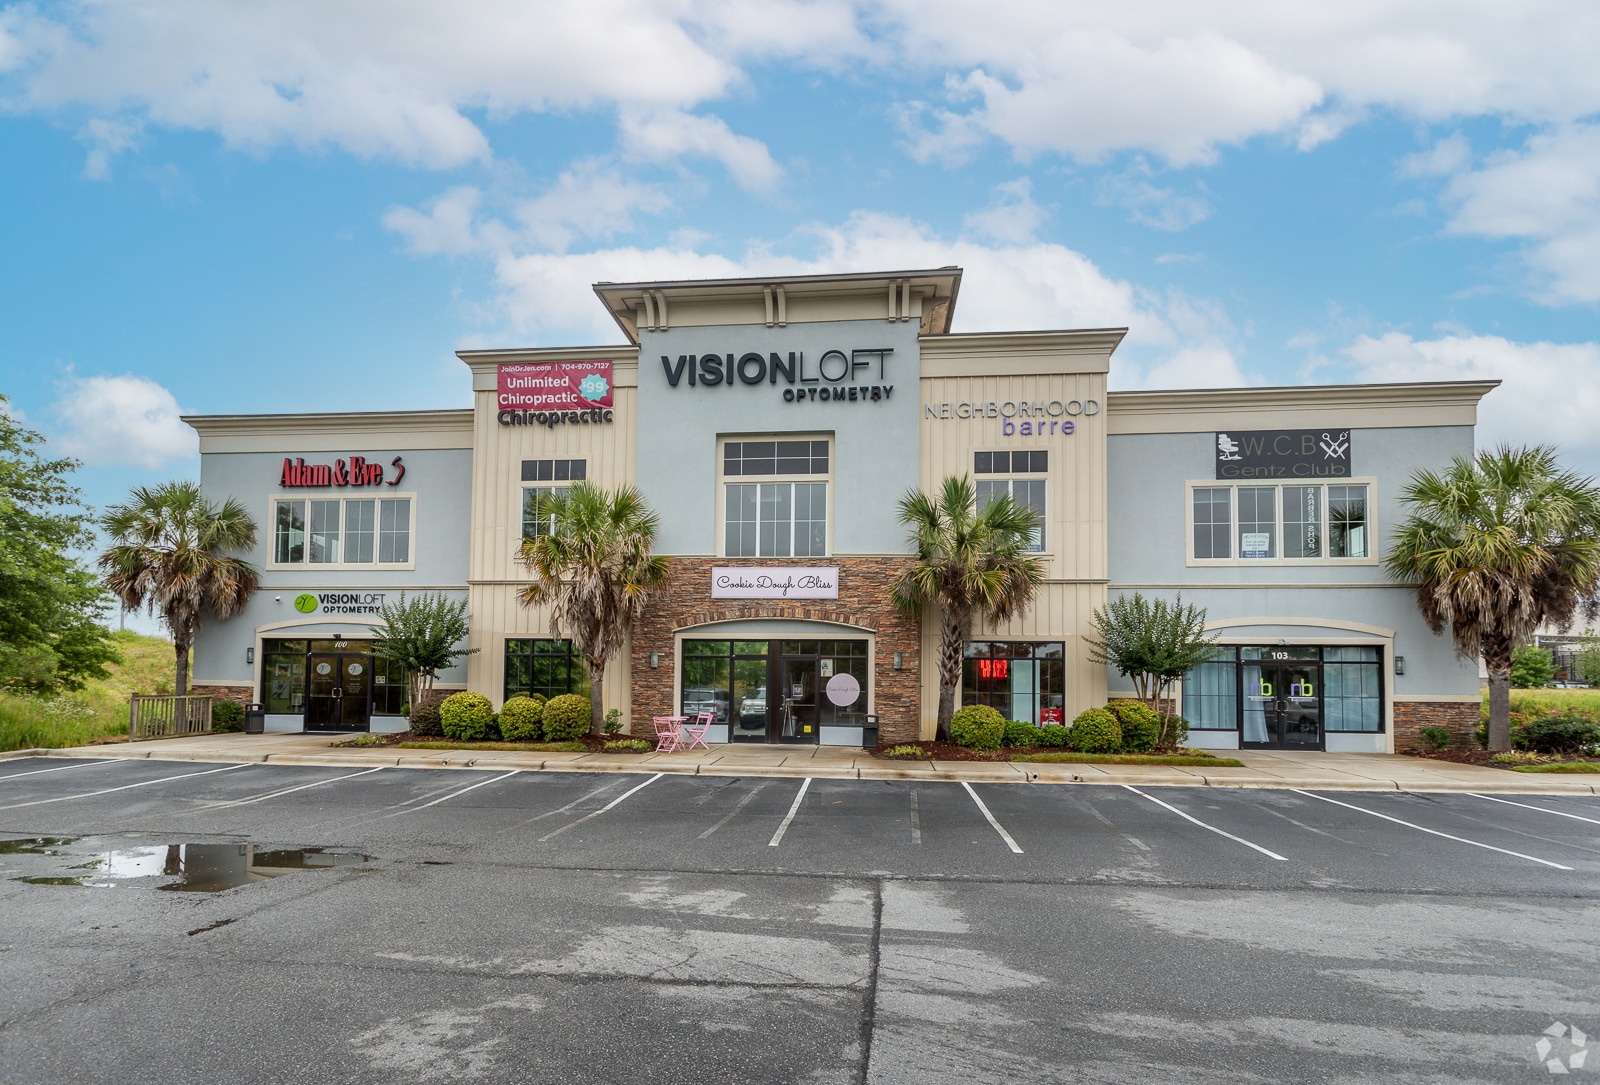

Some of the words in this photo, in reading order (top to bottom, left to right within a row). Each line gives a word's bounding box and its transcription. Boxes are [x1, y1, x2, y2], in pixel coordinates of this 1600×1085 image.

[501, 365, 551, 373] JoinDrJen.com
[661, 348, 894, 386] VISIONLOFT
[507, 376, 569, 389] Unlimited
[499, 392, 578, 405] Chiropractic
[783, 385, 894, 403] OPTOMETRY
[497, 407, 613, 428] Chiropractic
[924, 400, 1100, 420] NEIGHBORHOOD
[1003, 417, 1076, 436] barre
[279, 456, 332, 488] Adam
[331, 458, 350, 487] &
[349, 455, 384, 487] Eve
[1221, 464, 1286, 478] Gentz
[1292, 462, 1346, 476] Club
[716, 575, 755, 589] Cookie
[756, 575, 796, 597] Dough
[797, 575, 833, 589] Bliss
[318, 593, 386, 605] VISIONLOFT
[1271, 652, 1289, 660] 103
[1290, 678, 1314, 697] nb
